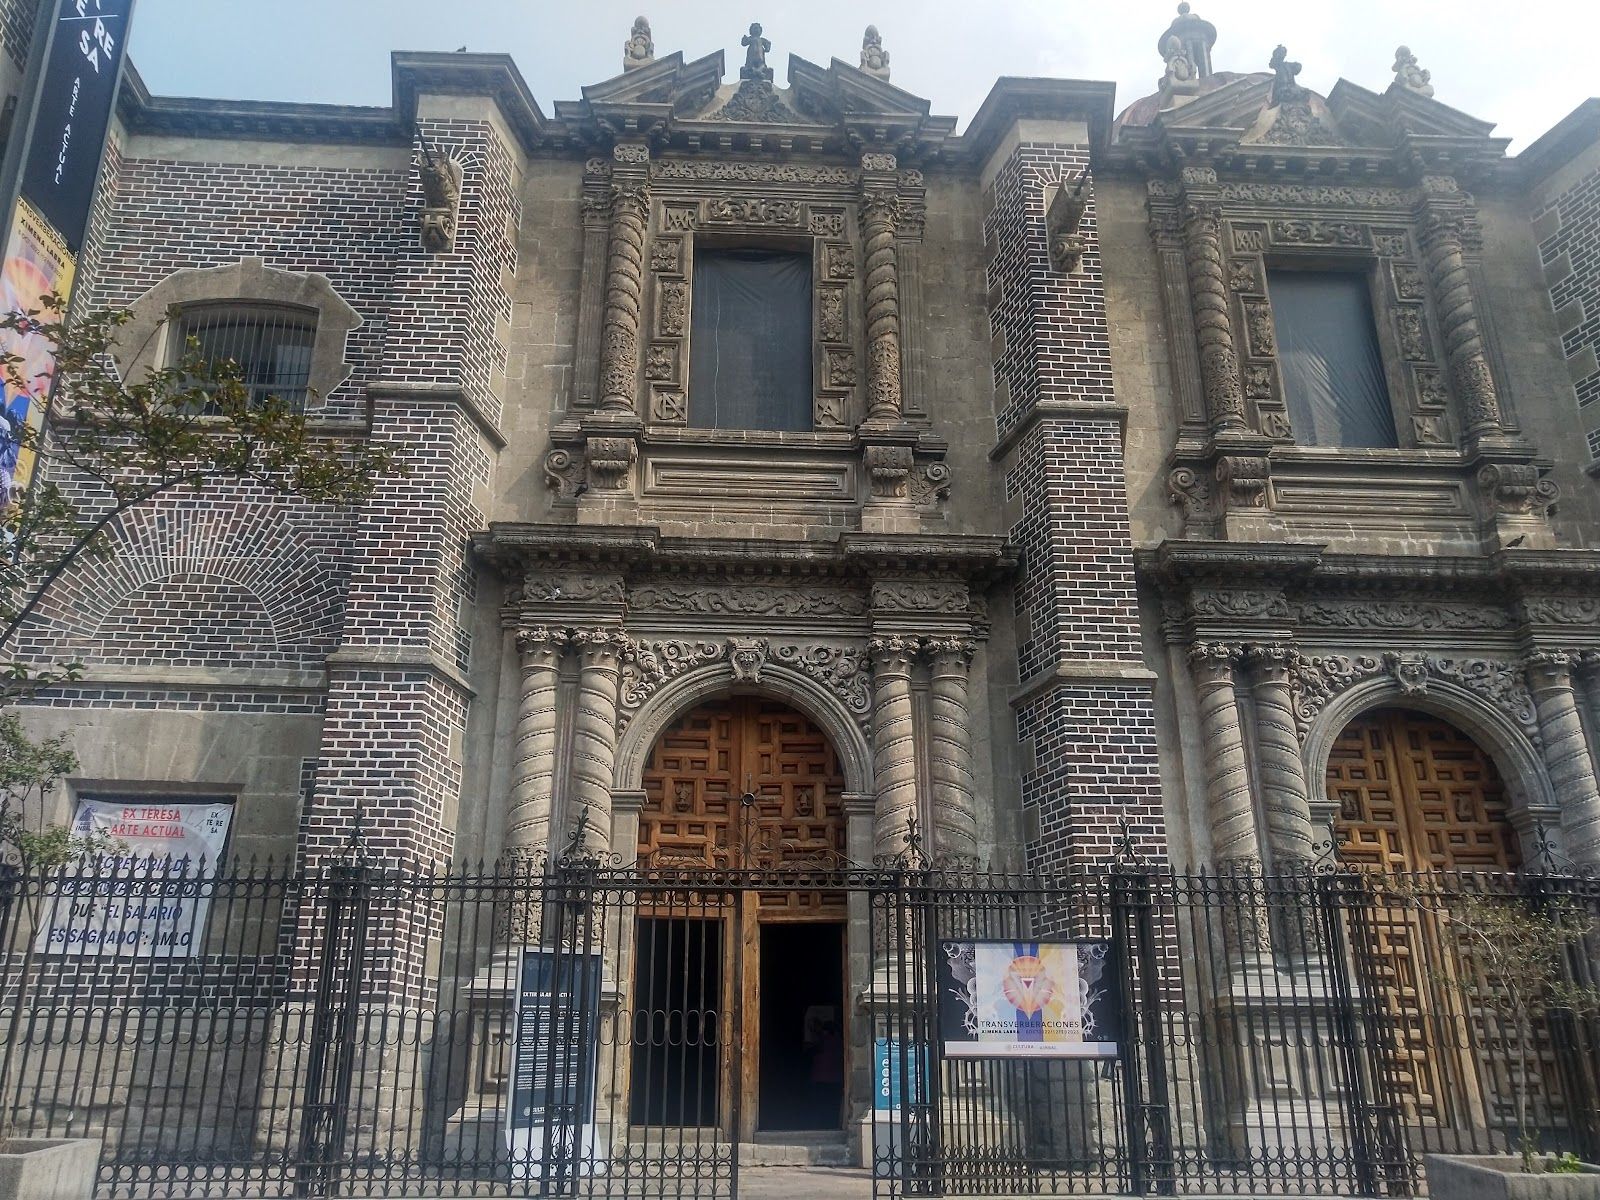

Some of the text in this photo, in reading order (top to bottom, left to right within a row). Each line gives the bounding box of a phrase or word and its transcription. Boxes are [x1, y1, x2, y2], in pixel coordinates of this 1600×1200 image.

[55, 77, 80, 185] ARTE ACTUAL
[122, 807, 182, 820] EX TERESA
[210, 811, 219, 819] EX
[110, 824, 185, 837] ARTE ACTUAL
[980, 1020, 1079, 1028] TRANSVERBERACIONES
